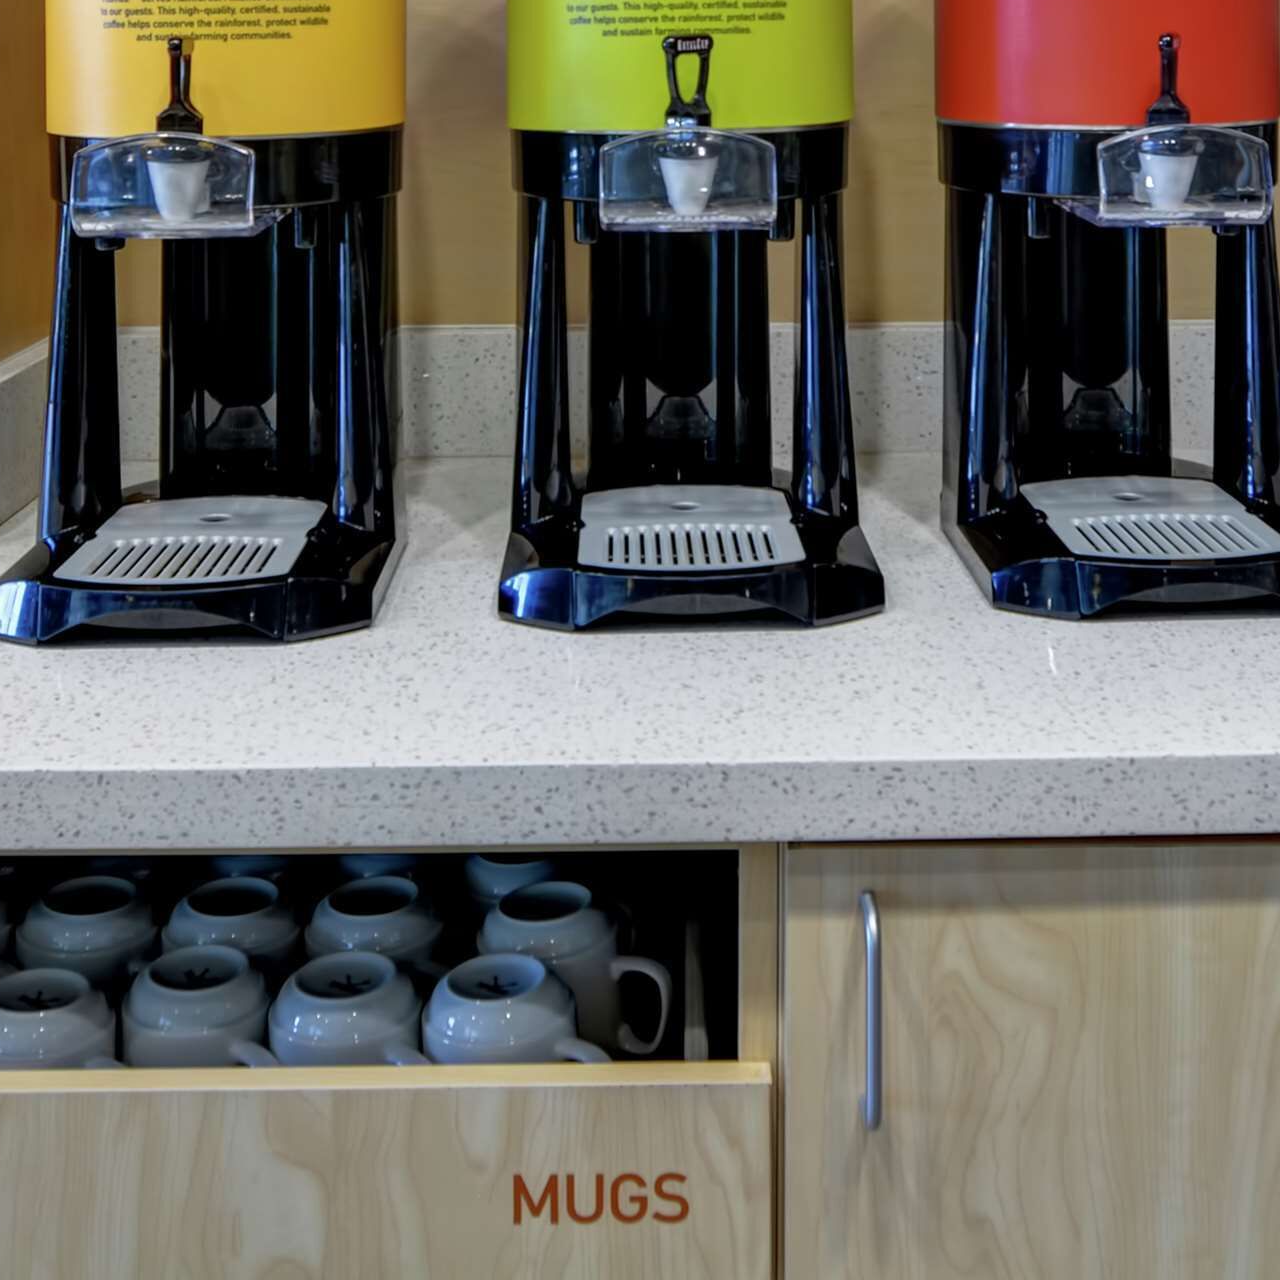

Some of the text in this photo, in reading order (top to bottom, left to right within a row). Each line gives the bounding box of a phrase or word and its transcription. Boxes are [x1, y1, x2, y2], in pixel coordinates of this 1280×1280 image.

[158, 6, 176, 15] This
[282, 3, 331, 13] sustainable
[624, 2, 641, 10] This
[742, 0, 787, 9] sustainable
[103, 20, 125, 28] coffee
[128, 20, 151, 30] helps
[197, 20, 212, 28] the
[265, 18, 297, 28] protect
[300, 17, 329, 26] wildlife
[593, 16, 616, 25] helps
[619, 16, 659, 24] conserve
[726, 14, 755, 23] protect
[136, 33, 152, 41] and
[602, 28, 618, 37] and
[512, 1173, 690, 1225] MUGS
